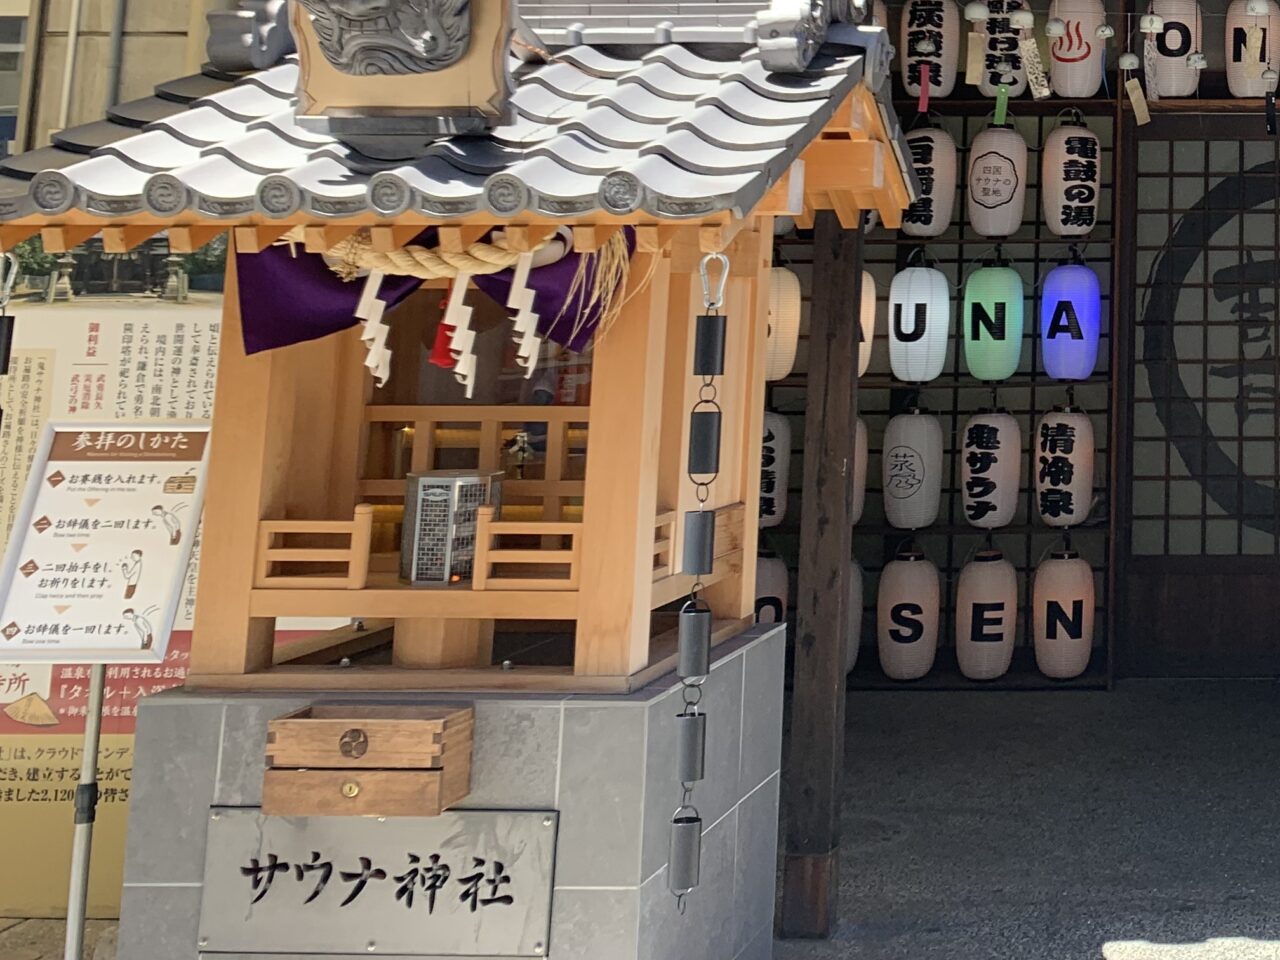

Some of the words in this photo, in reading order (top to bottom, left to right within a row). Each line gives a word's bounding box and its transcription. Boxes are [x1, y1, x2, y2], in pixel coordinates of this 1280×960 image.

[72, 432, 189, 451] 参拝のしかた
[965, 423, 1000, 521] 鬼サウナ
[1040, 422, 1075, 517] 清冷泉
[240, 851, 514, 915] サウナ神社
